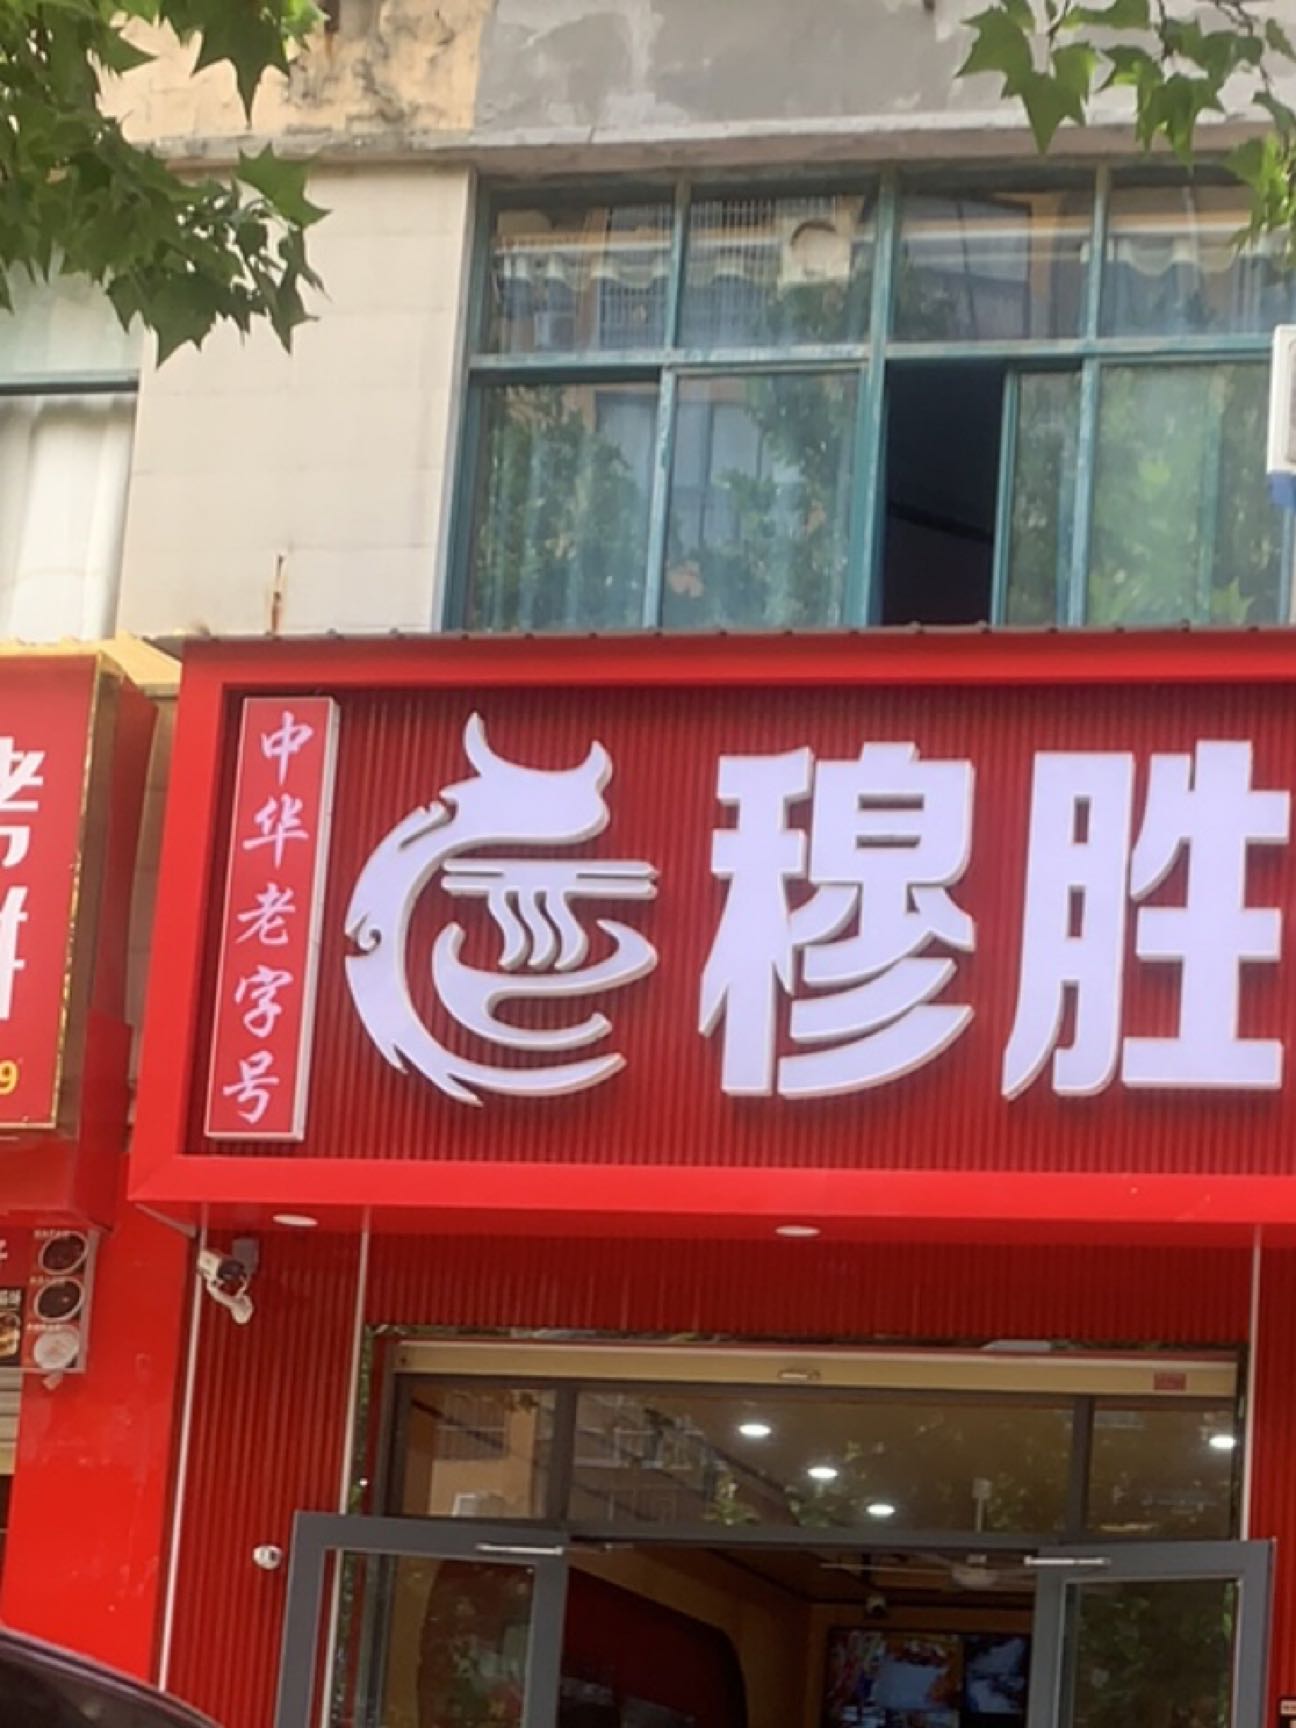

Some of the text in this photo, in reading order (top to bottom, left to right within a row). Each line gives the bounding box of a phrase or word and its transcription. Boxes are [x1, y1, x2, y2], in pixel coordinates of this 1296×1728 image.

[222, 711, 314, 1126] 中华老字号
